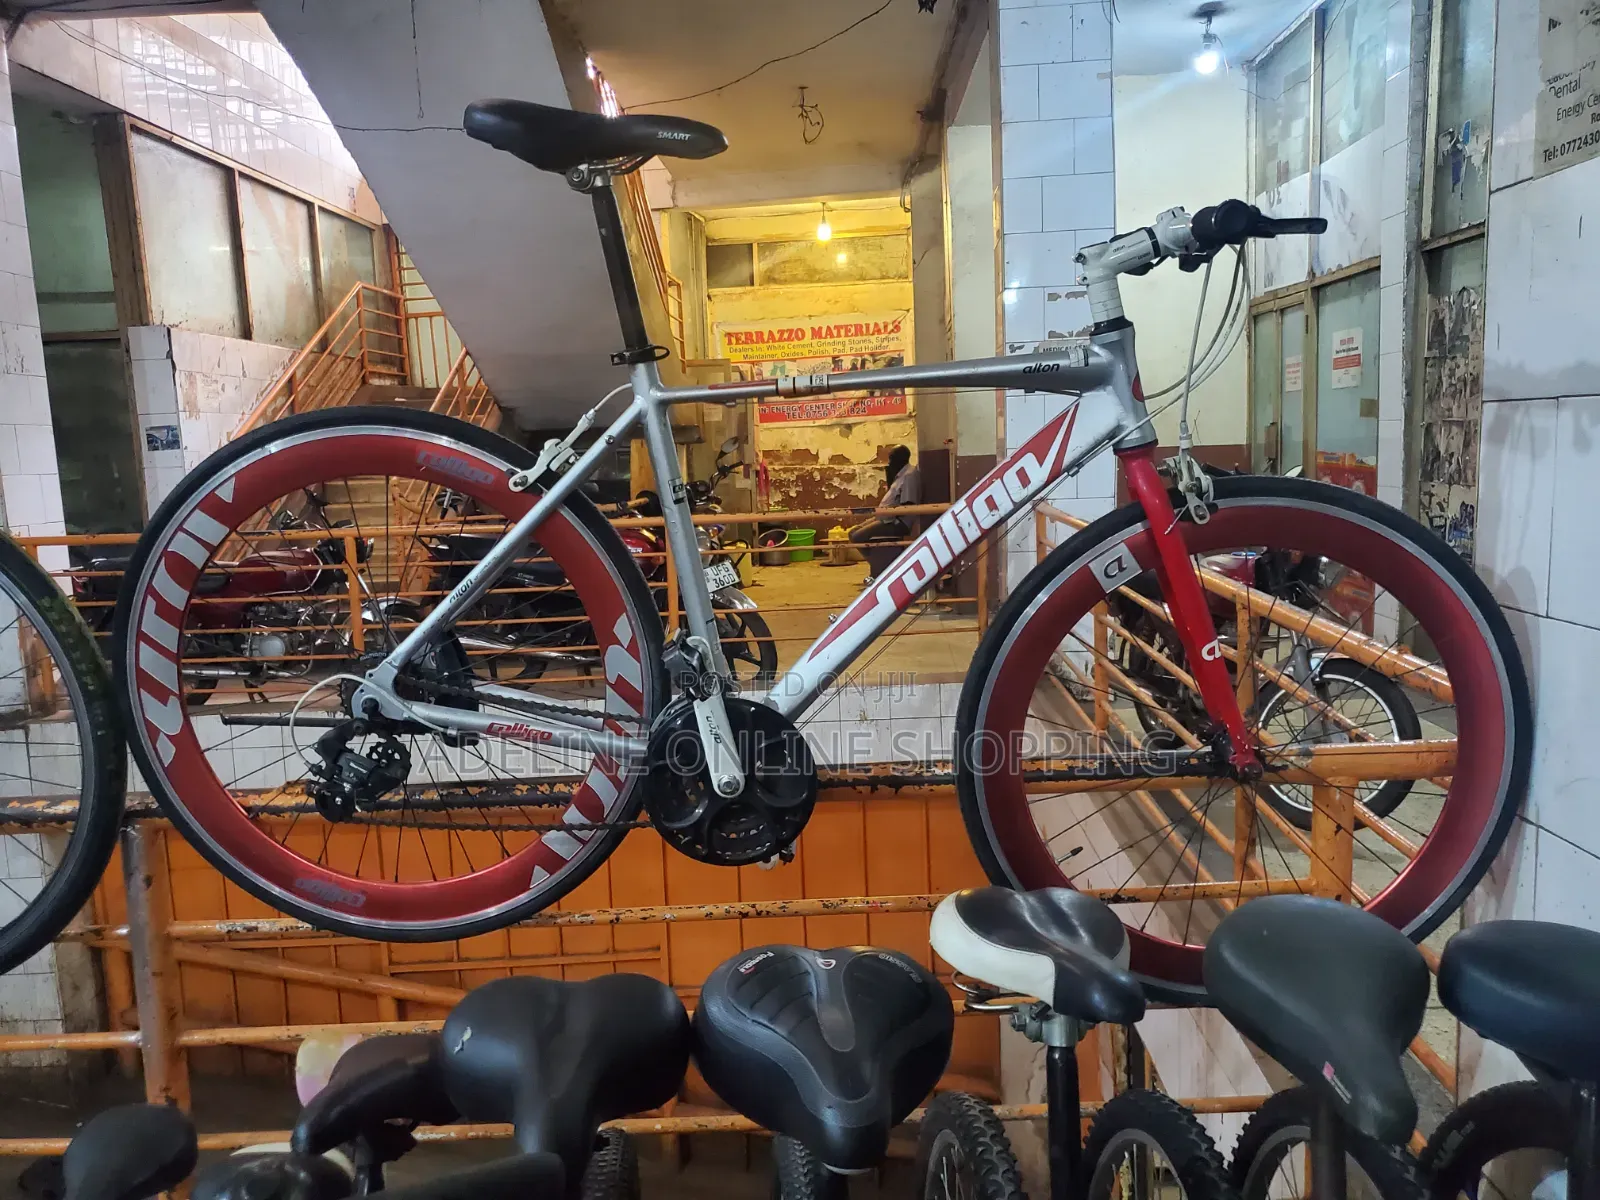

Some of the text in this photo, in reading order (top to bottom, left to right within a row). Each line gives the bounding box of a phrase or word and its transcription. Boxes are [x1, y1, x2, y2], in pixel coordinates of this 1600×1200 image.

[1557, 101, 1585, 121] Energy
[657, 131, 691, 141] SMART
[1543, 146, 1558, 162] Tel:
[724, 320, 901, 346] TERRAZZO MATERIALS
[817, 339, 846, 348] Grinding
[848, 337, 874, 346] Stones,
[1023, 363, 1060, 374] alton
[771, 405, 802, 413] ENERGY
[804, 402, 835, 412] CENTER
[711, 563, 730, 576] UFG
[706, 715, 722, 744] alton
